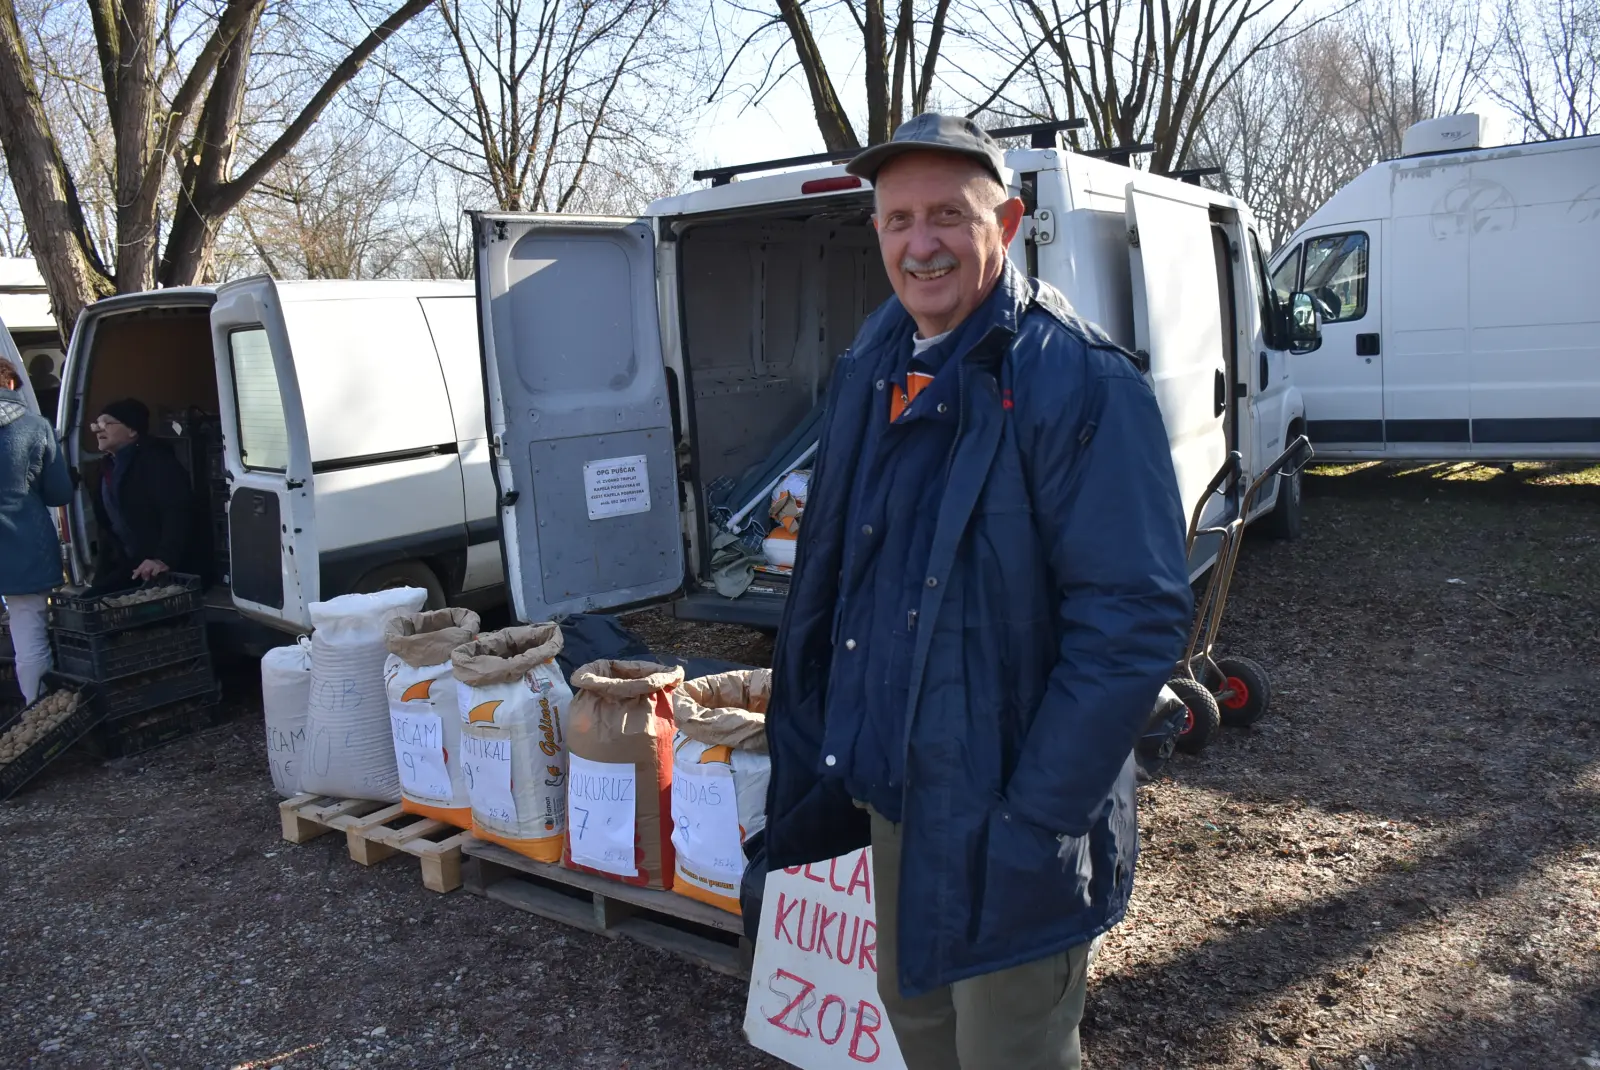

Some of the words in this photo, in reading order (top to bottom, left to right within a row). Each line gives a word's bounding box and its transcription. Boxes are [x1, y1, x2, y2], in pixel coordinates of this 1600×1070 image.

[538, 697, 561, 756] Galina
[284, 760, 293, 777] €
[402, 751, 416, 782] 9
[570, 771, 633, 801] KUKURUZ
[574, 806, 589, 840] 7
[678, 815, 690, 844] 8
[767, 968, 882, 1063] ZOB
